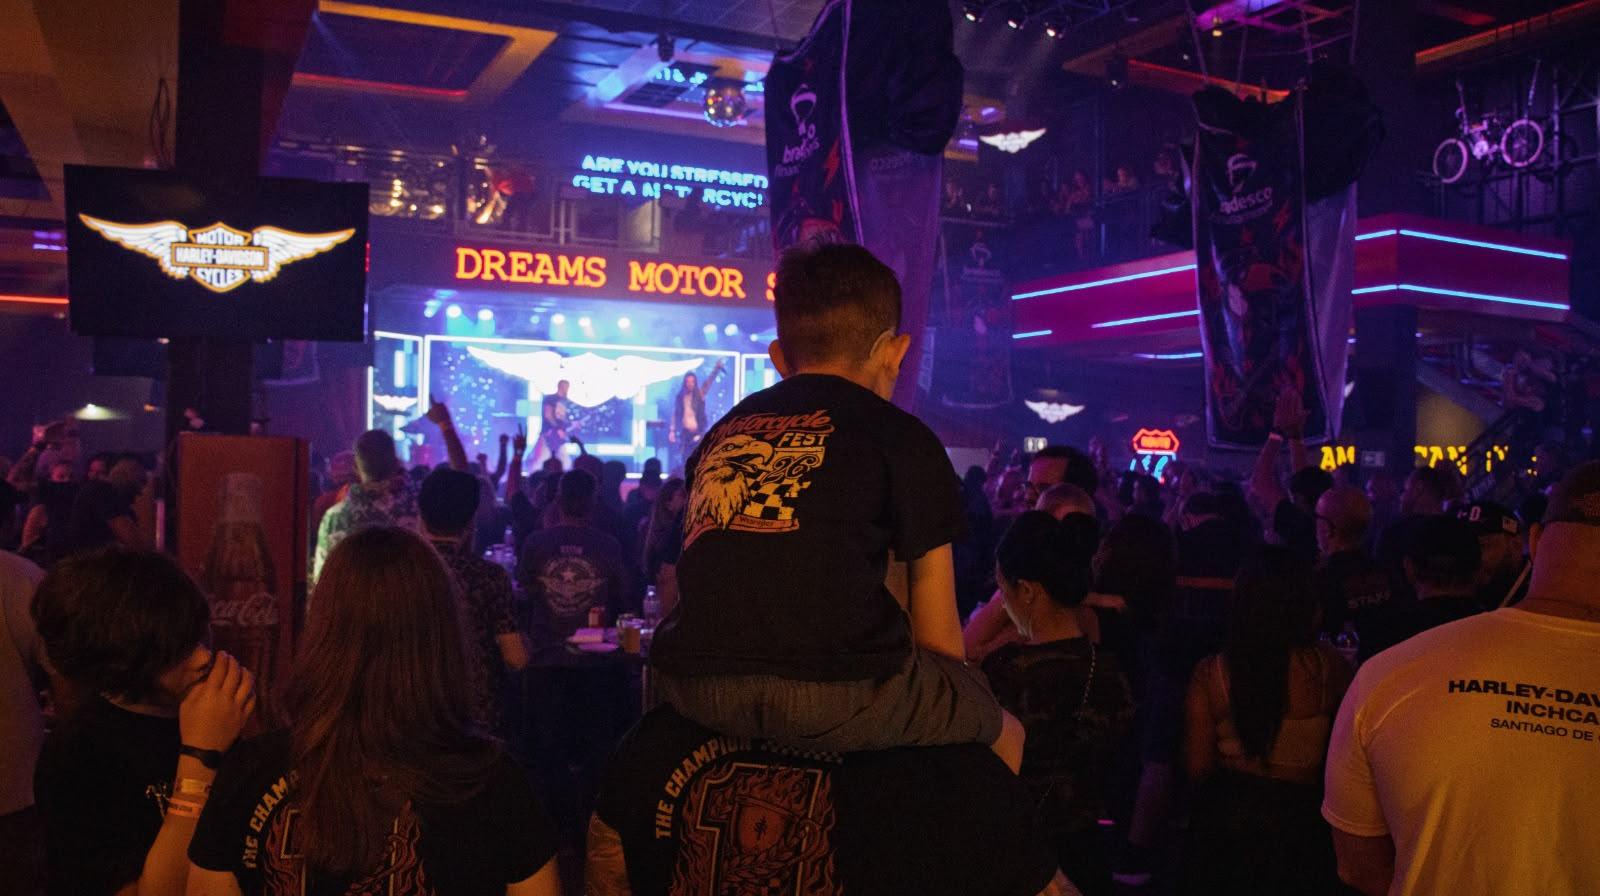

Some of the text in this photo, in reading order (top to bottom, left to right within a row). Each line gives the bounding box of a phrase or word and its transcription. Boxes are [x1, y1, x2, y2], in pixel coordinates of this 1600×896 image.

[582, 155, 624, 173] ARE
[626, 161, 668, 178] YOU
[671, 165, 768, 188] STRESSED
[573, 175, 618, 194] GET
[621, 180, 636, 196] A
[196, 228, 244, 246] MOTOR
[176, 247, 264, 266] HARLEY-DAVIDSON
[197, 268, 243, 288] CYCLES
[456, 247, 606, 288] DREAMS
[629, 261, 746, 299] MOTOR
[777, 432, 829, 447] FEST
[739, 515, 774, 528] Wrangler
[1490, 718, 1593, 741] SANTIAGO DE
[655, 800, 675, 840] THE
[241, 834, 259, 871] THE
